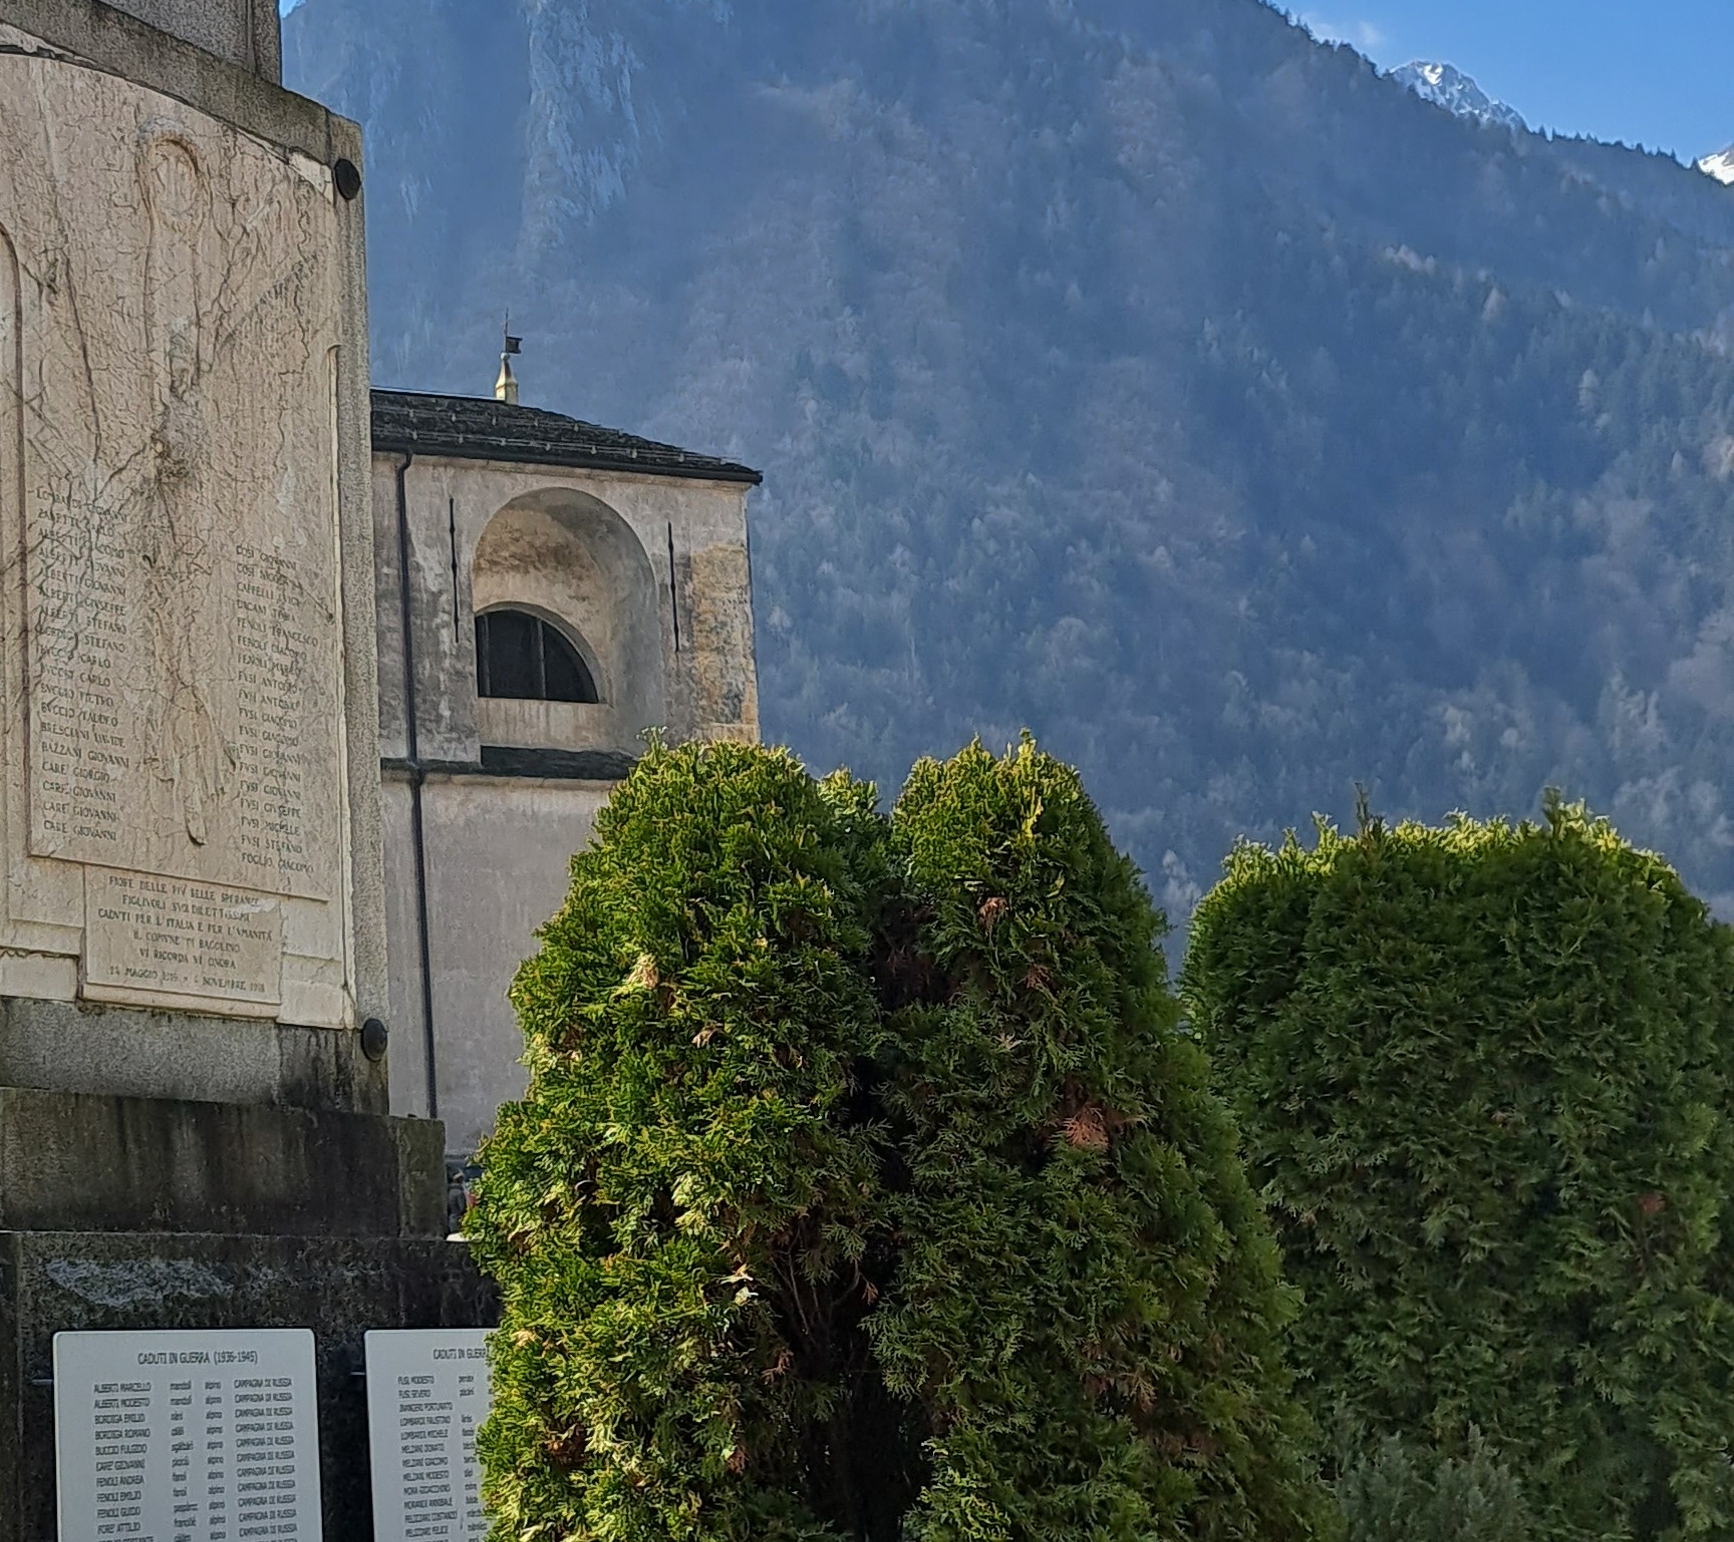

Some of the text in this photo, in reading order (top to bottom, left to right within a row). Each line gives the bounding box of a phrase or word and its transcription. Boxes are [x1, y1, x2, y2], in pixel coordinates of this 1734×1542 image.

[139, 880, 167, 894] DELLE
[190, 888, 215, 901] BELLE
[135, 913, 152, 925] PER
[208, 923, 223, 935] PER
[199, 938, 240, 954] BAGOLINO
[154, 950, 189, 964] RICORDA
[138, 1353, 167, 1365] CADUTI
[169, 1353, 178, 1365] IN
[180, 1352, 211, 1365] GUERRA
[433, 1349, 457, 1360] CADUTI
[458, 1349, 465, 1360] IN
